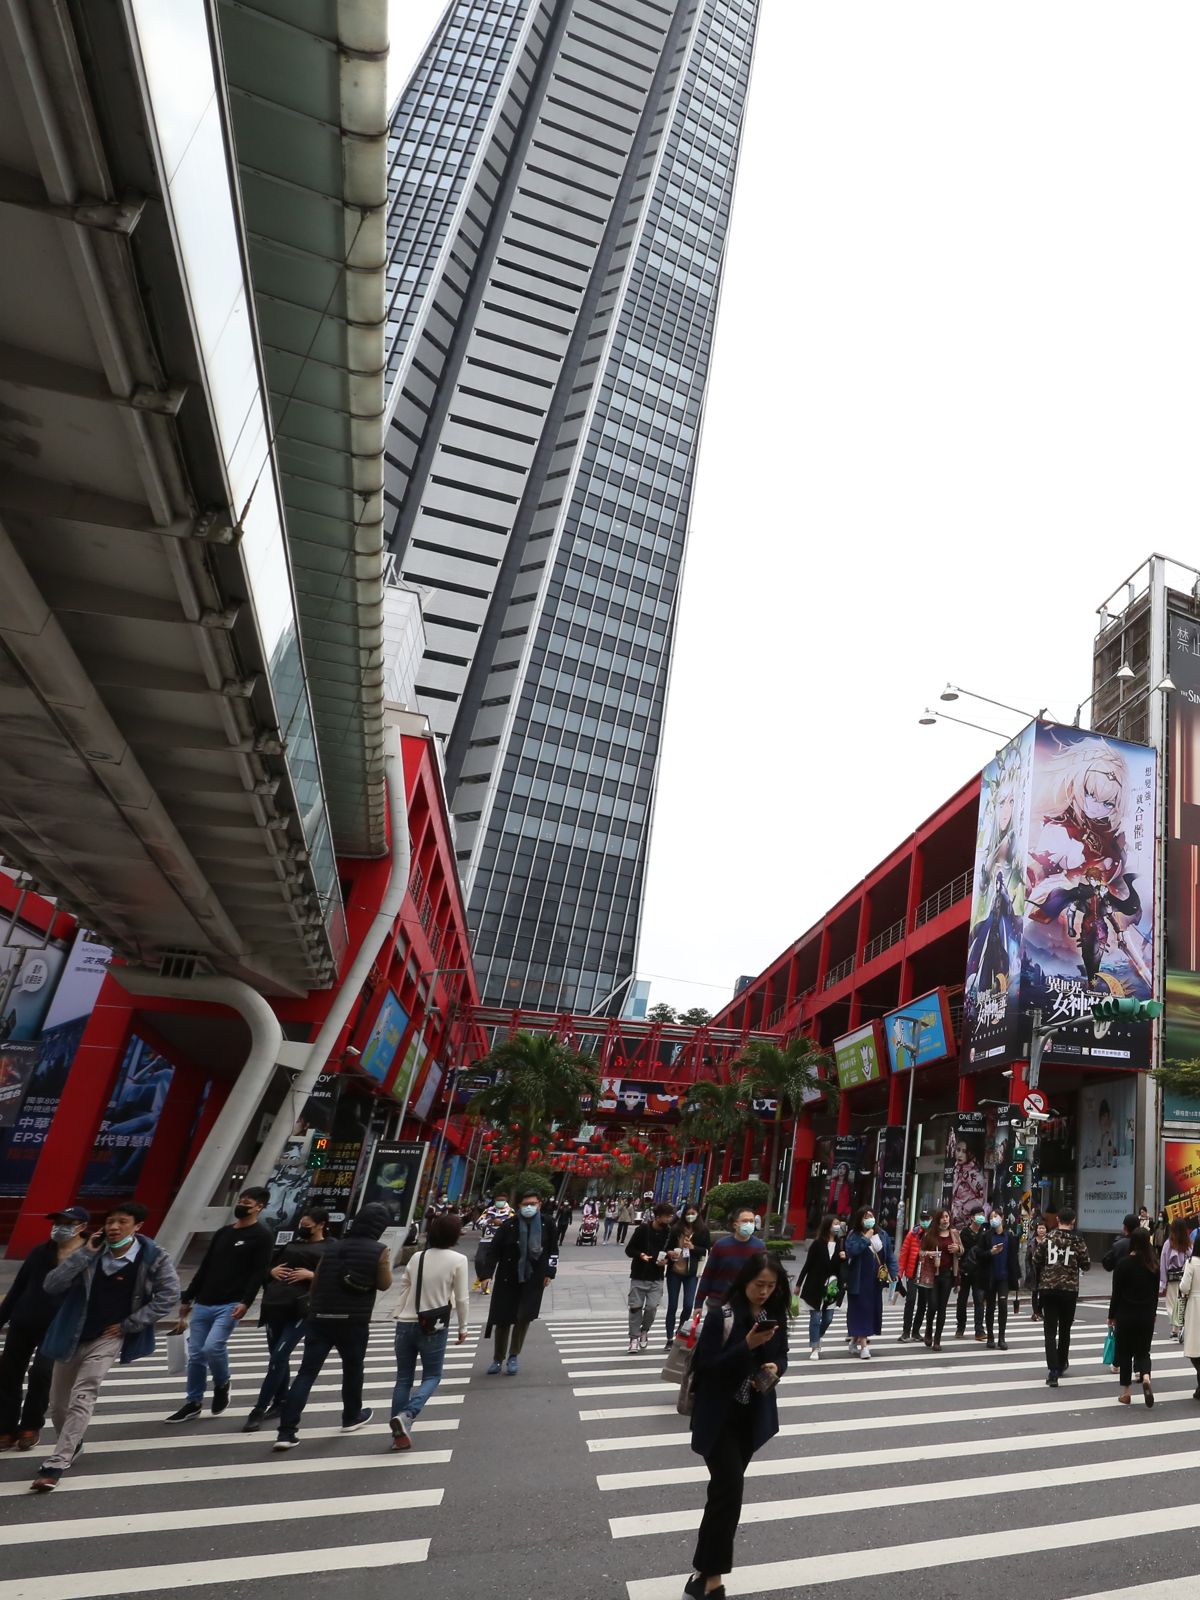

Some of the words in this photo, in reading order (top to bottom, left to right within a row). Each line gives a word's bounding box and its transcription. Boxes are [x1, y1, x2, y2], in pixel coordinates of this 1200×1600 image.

[959, 1113, 971, 1121] ONE
[19, 1117, 54, 1129] 中華
[315, 1139, 329, 1150] 19
[1015, 1163, 1023, 1173] 19
